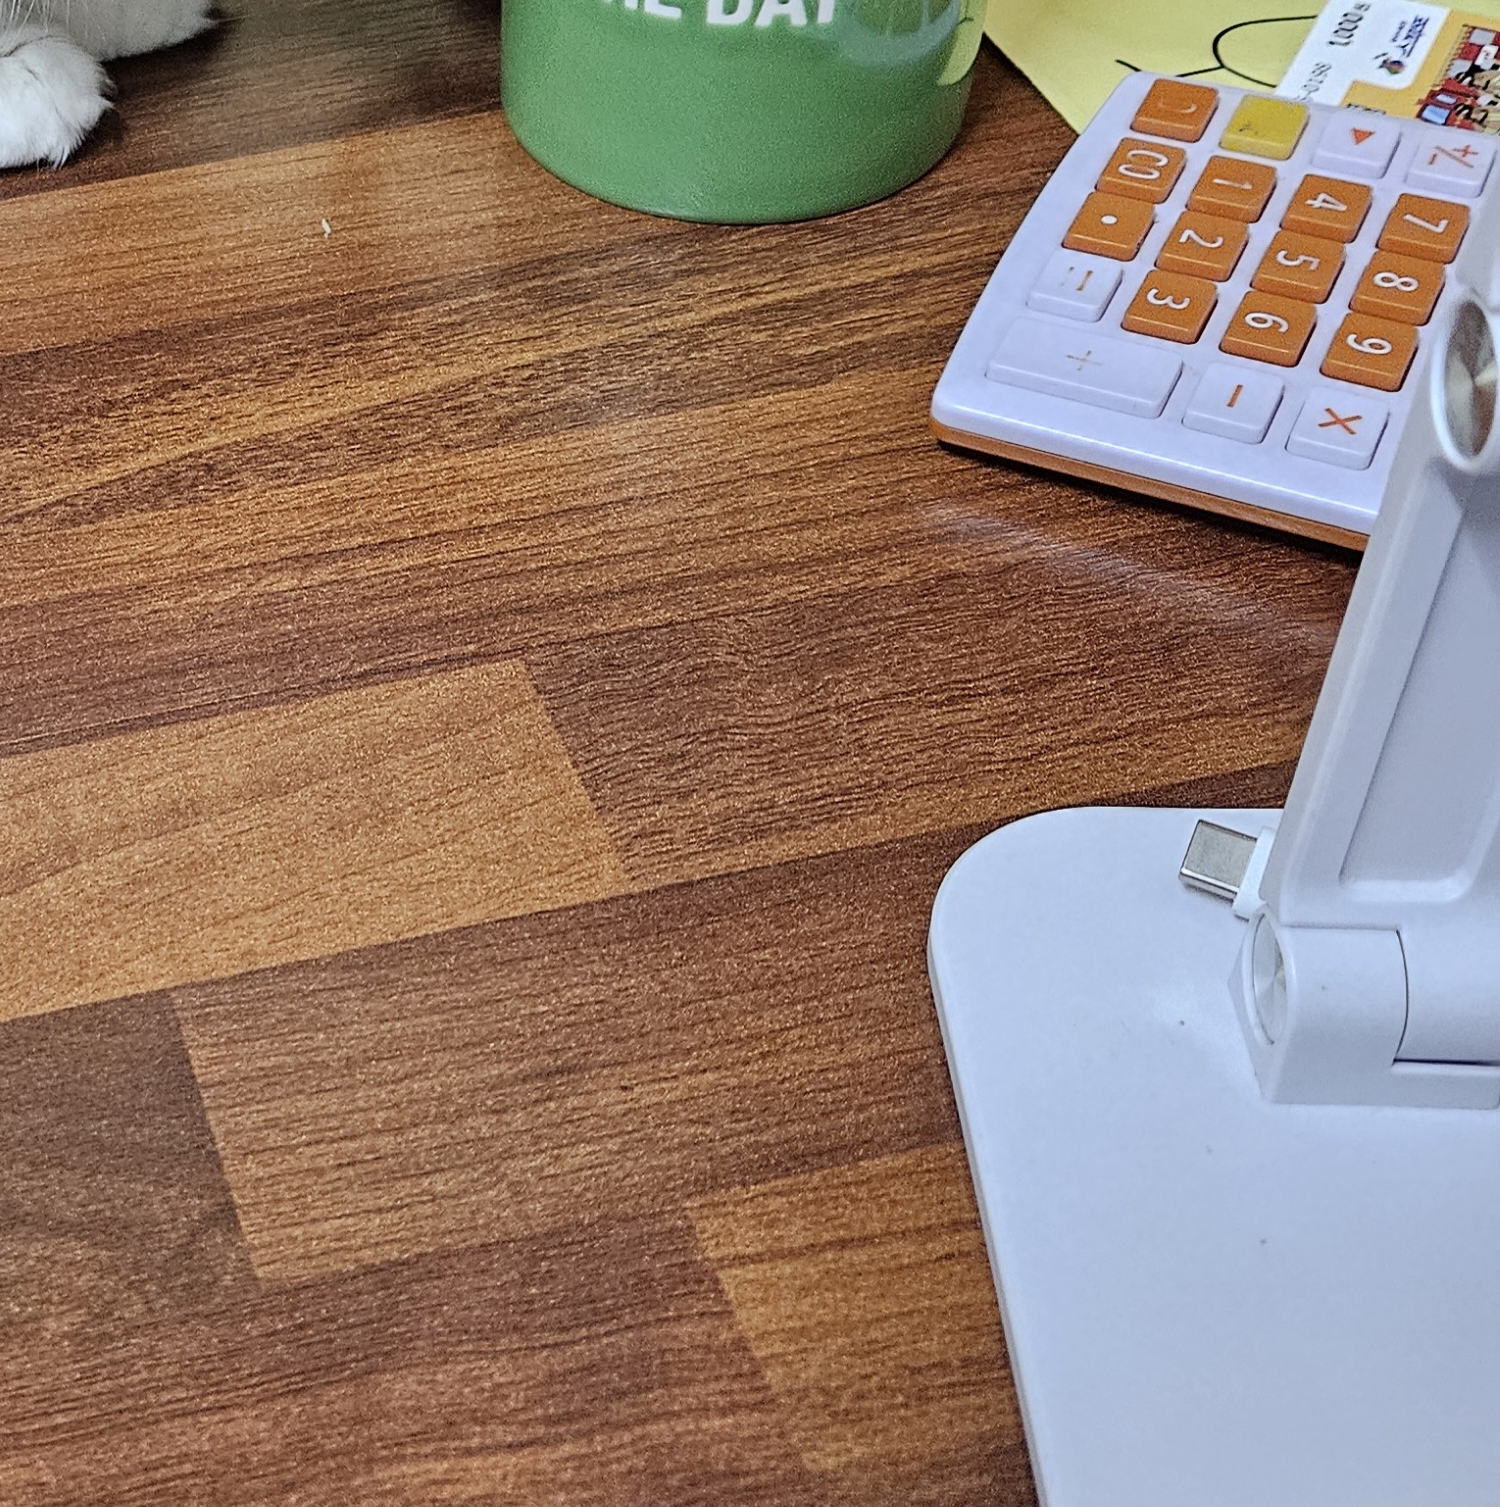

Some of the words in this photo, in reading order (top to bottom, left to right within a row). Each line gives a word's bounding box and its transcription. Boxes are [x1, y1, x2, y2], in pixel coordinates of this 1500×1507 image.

[1211, 176, 1254, 191] 1
[1303, 191, 1349, 213] 4
[1402, 212, 1450, 235] 7
[1179, 228, 1225, 250] 2
[1276, 249, 1321, 272] 5
[1372, 271, 1419, 293] 8
[1146, 287, 1192, 310] 3
[1243, 311, 1290, 335] 6
[1345, 333, 1393, 357] 9
